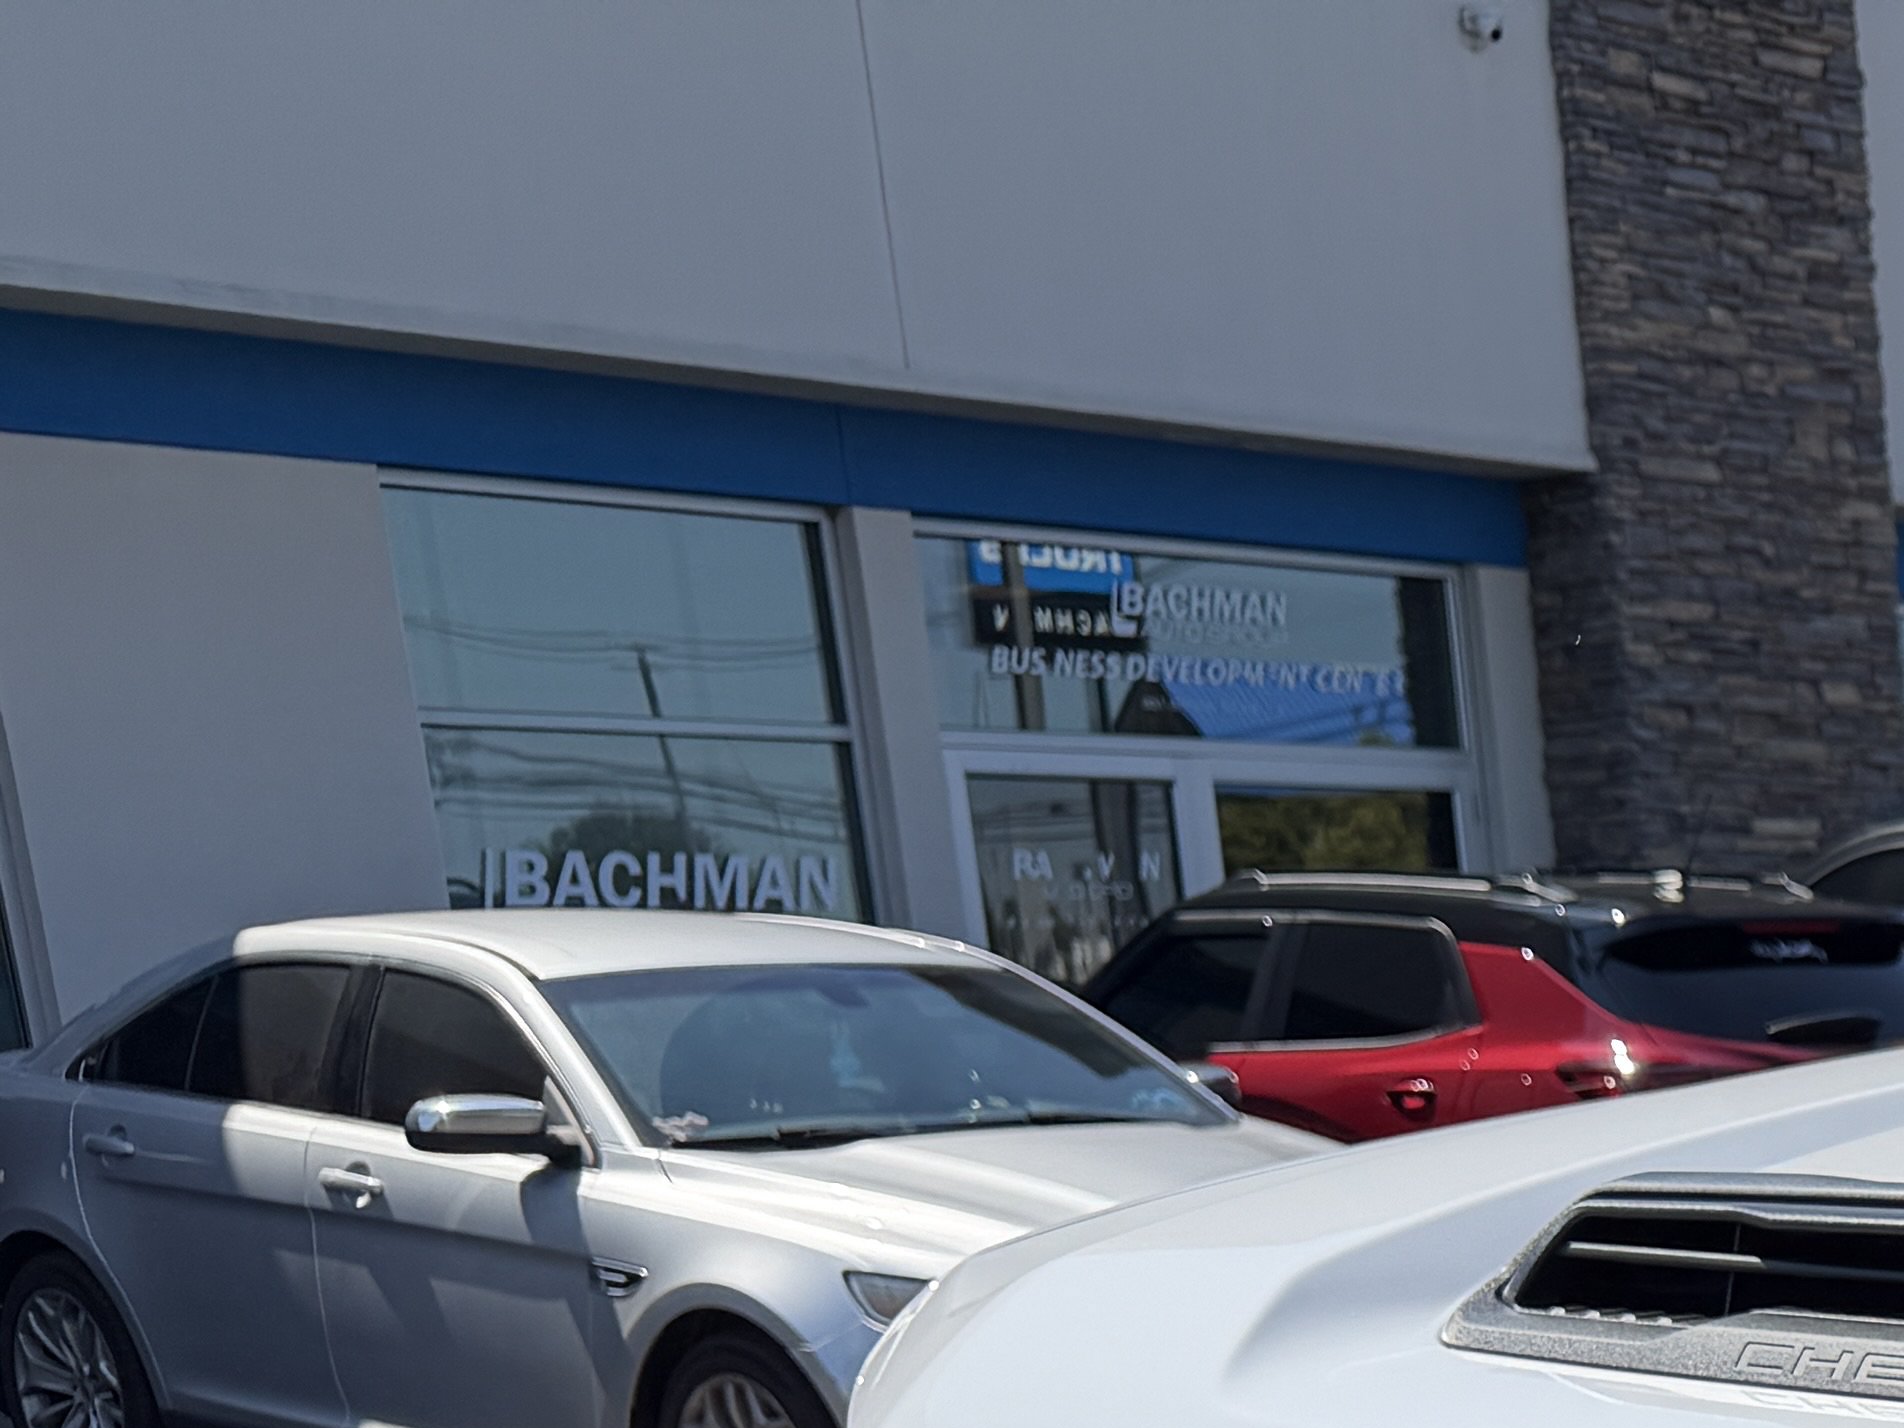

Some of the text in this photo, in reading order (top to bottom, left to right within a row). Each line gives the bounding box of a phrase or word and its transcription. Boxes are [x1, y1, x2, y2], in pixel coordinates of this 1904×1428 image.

[1120, 580, 1287, 626] BACHMAN
[991, 644, 1122, 680] BUSNESS
[504, 849, 836, 911] BACHMAN
